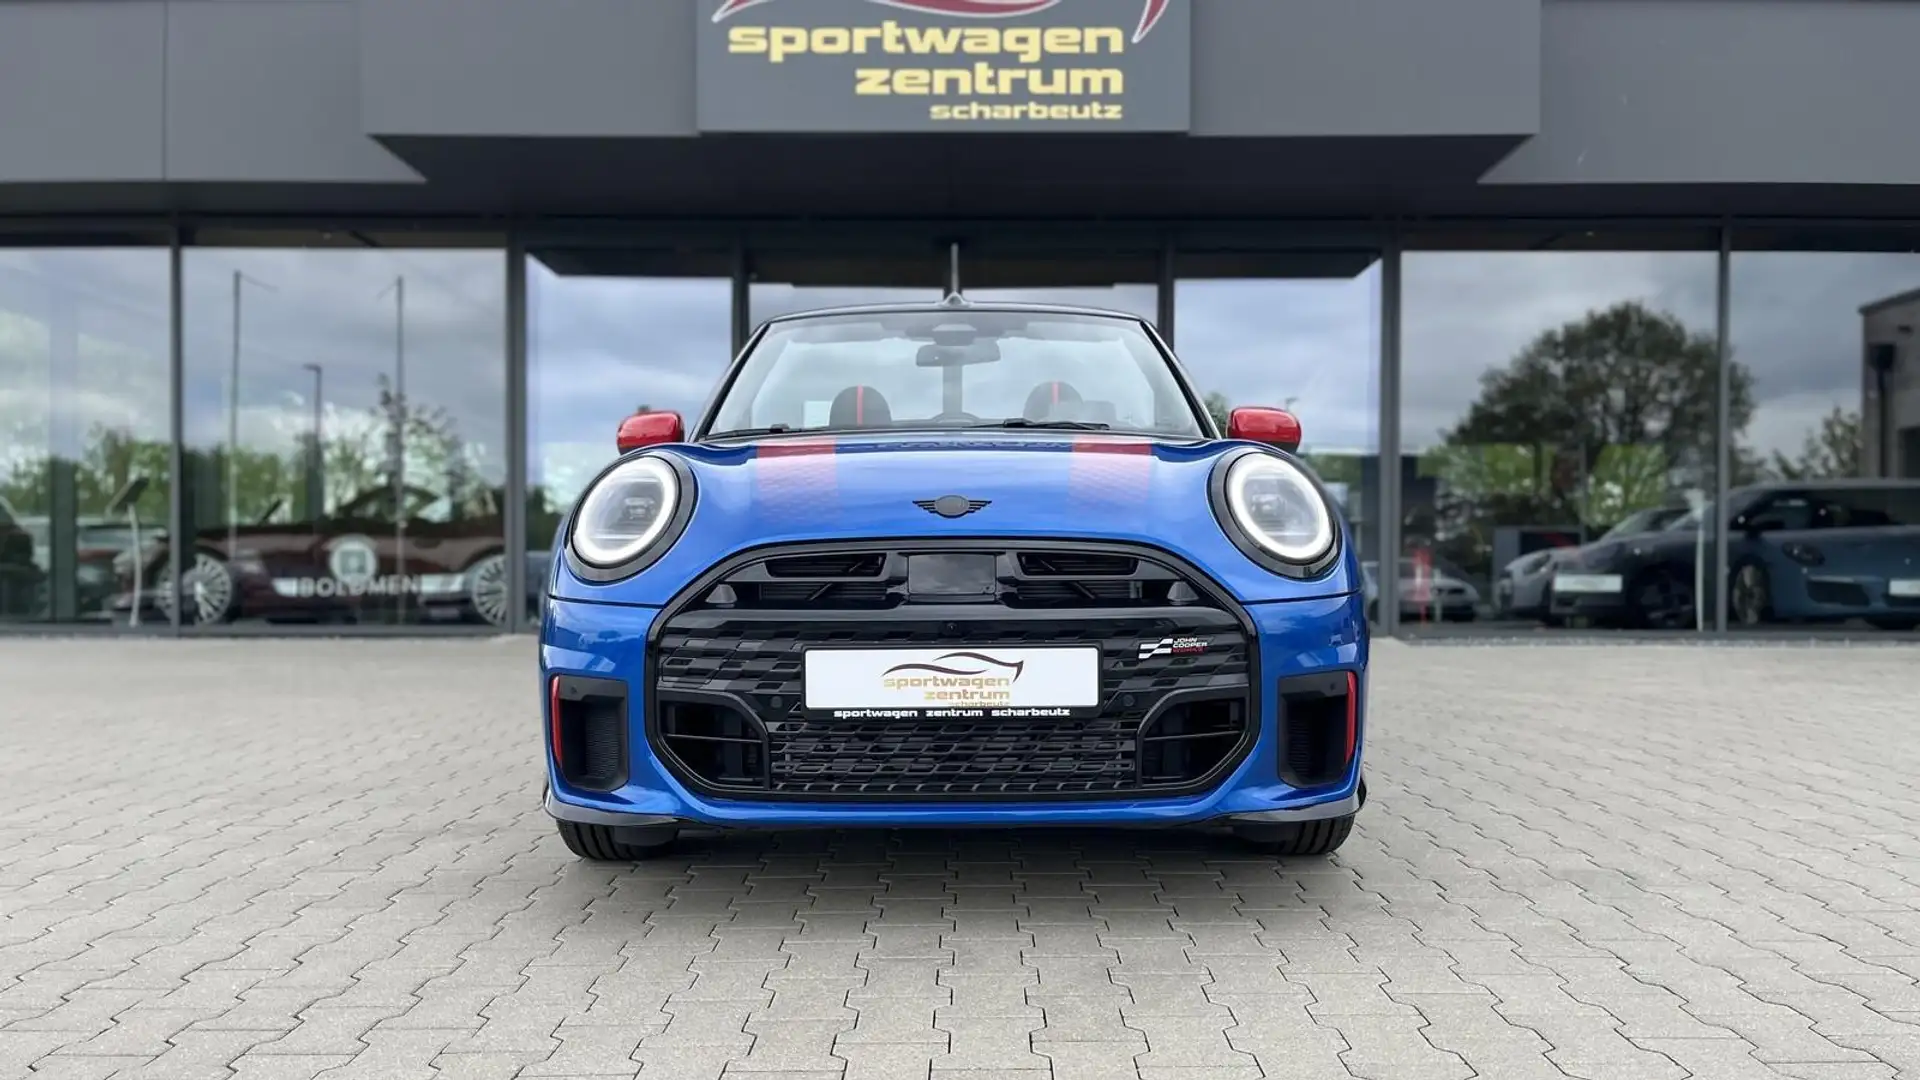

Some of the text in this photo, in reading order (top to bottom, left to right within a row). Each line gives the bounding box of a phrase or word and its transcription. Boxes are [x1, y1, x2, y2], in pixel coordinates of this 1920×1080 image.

[728, 20, 1123, 62] sportwagen
[855, 62, 1123, 94] zentrum
[930, 102, 1123, 119] scharbeutz
[884, 676, 1009, 689] sportwagen
[924, 690, 1009, 700] zentrum
[834, 707, 1070, 719] sportwagen zentrum scharbeutz
